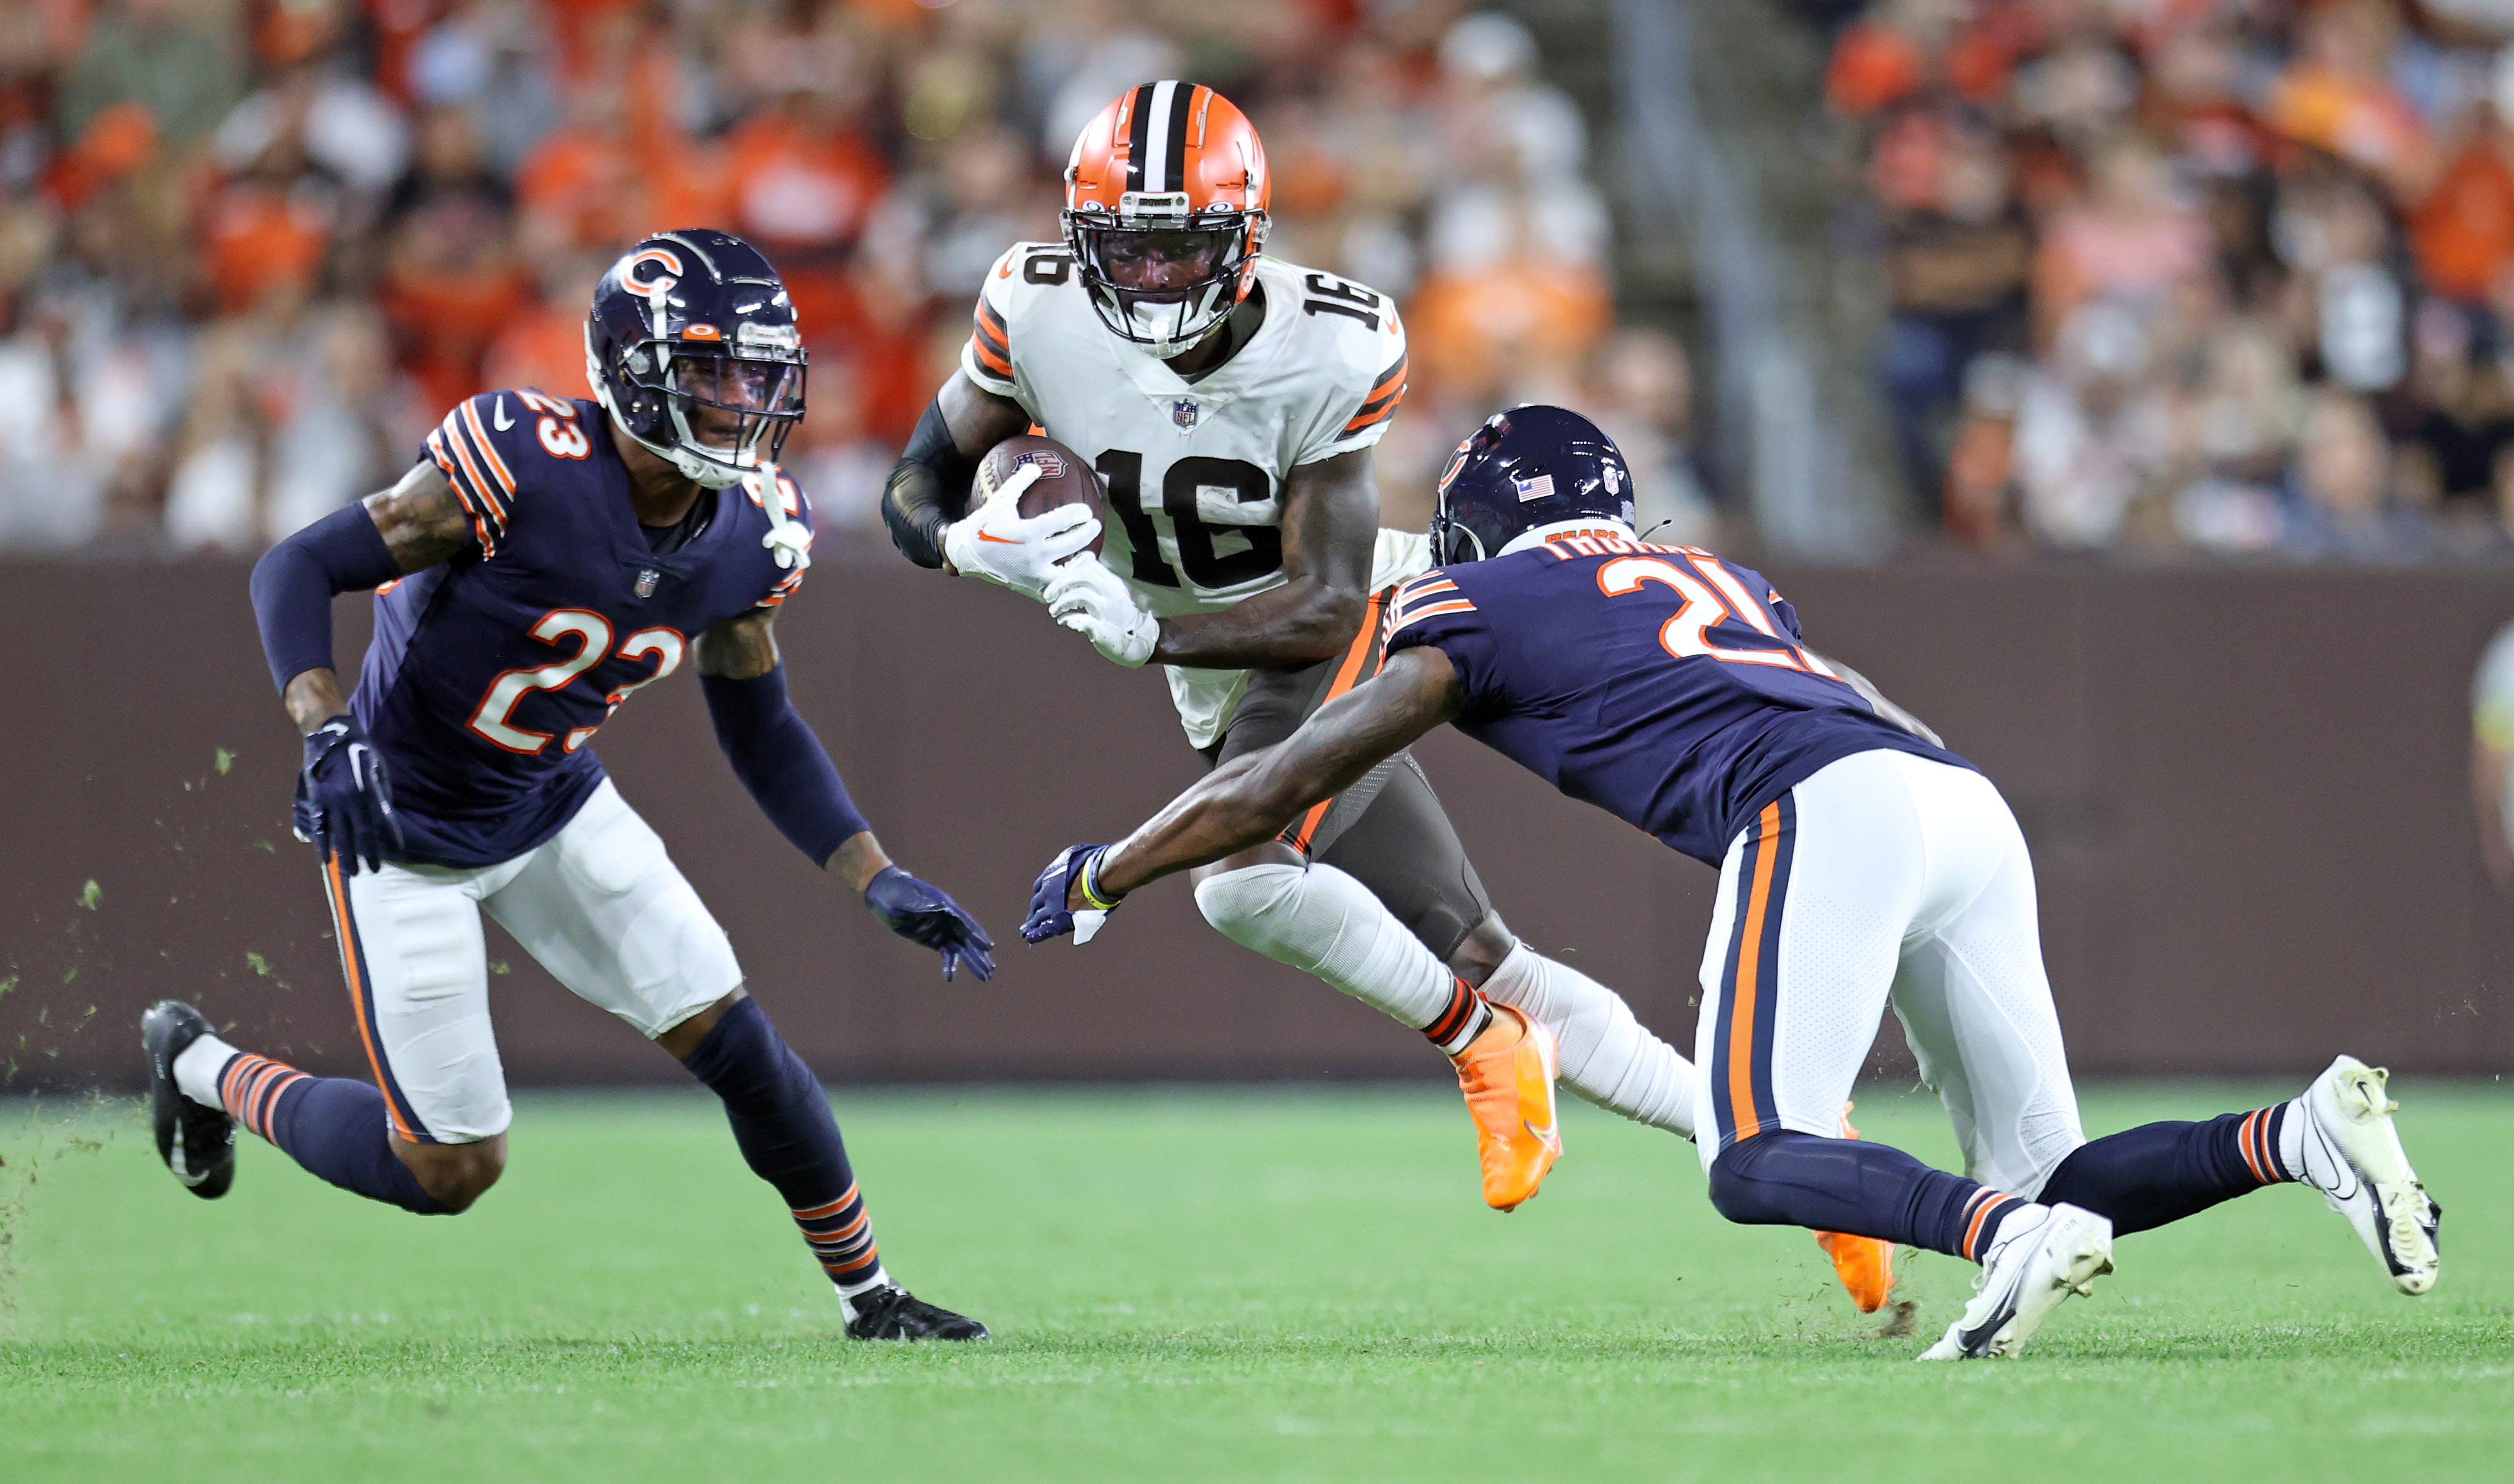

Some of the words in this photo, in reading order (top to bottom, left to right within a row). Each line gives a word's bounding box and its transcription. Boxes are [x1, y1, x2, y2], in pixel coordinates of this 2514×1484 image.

[619, 247, 684, 298] C
[1303, 274, 1379, 332] 16
[516, 388, 592, 461] 23
[1177, 412, 1194, 424] NFL
[1034, 453, 1061, 474] NFL
[1096, 449, 1283, 589] 16
[465, 607, 686, 755] 23
